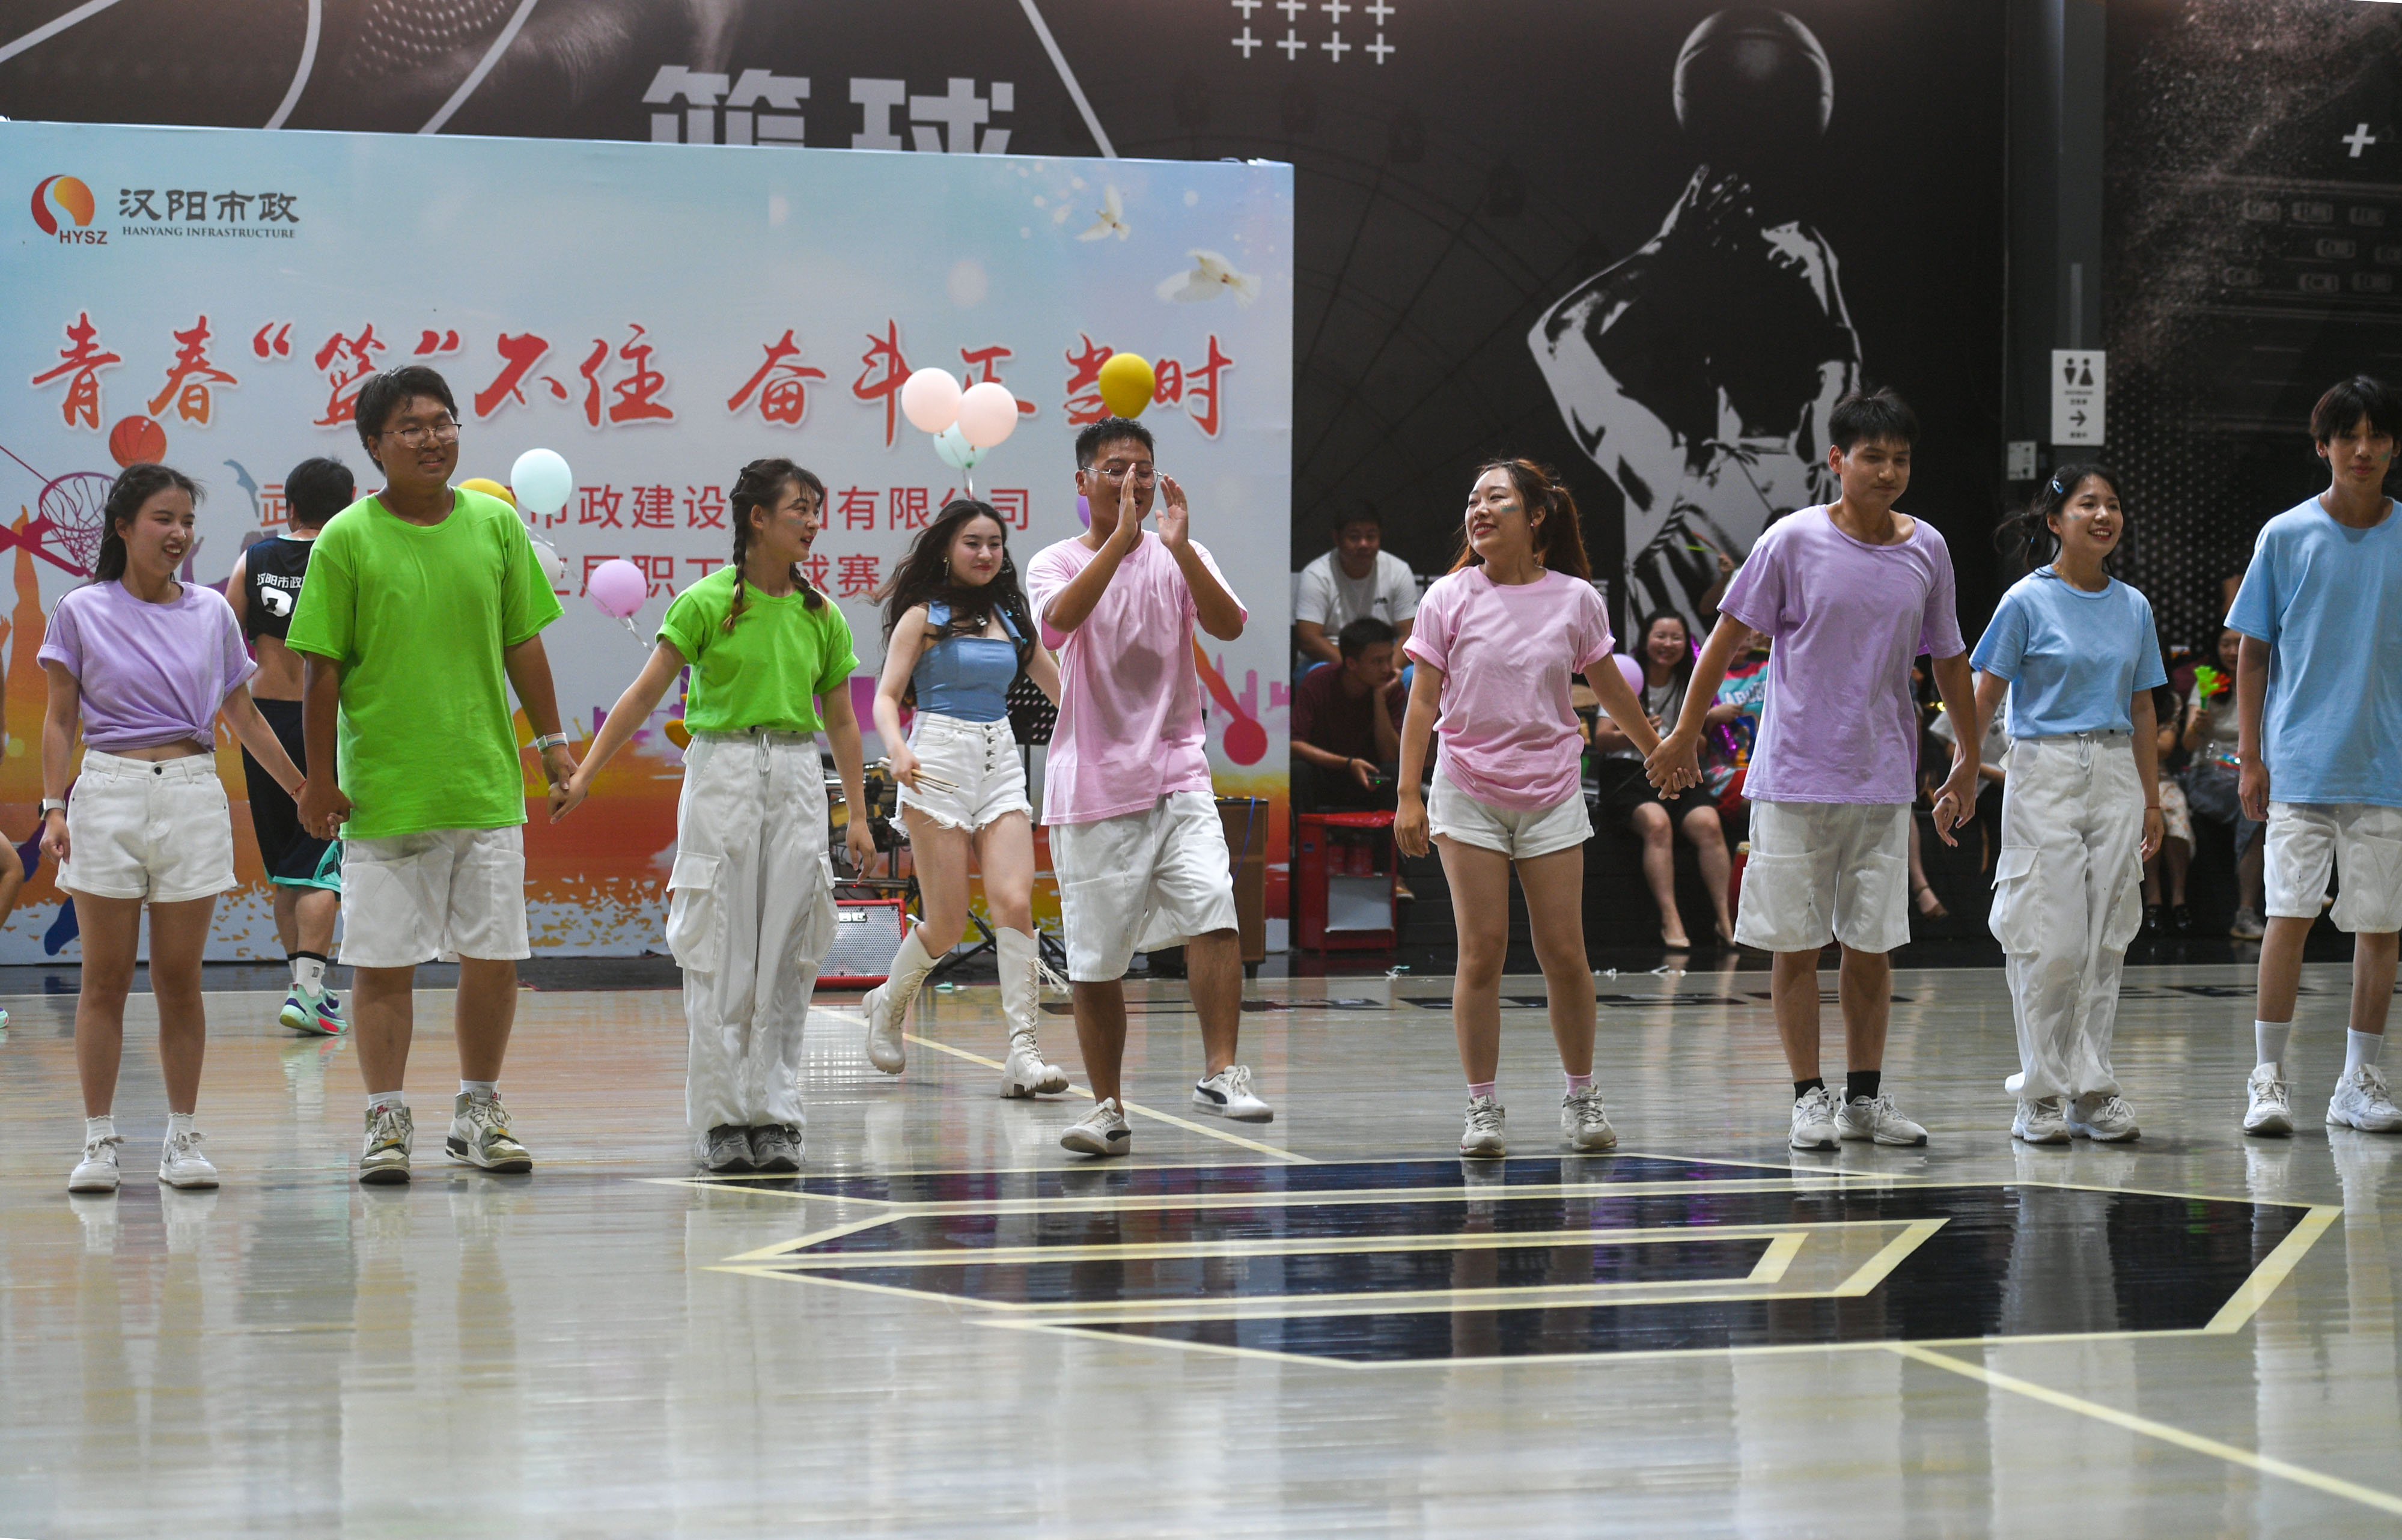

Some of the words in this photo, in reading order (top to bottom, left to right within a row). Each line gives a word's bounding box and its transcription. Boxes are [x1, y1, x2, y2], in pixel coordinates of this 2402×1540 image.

[119, 189, 300, 223] 汉阳市政
[60, 231, 108, 245] HYSZ
[123, 226, 183, 237] HANYANG
[187, 227, 296, 239] INFRASTRUCTURE
[256, 572, 305, 588] 汉阳市政
